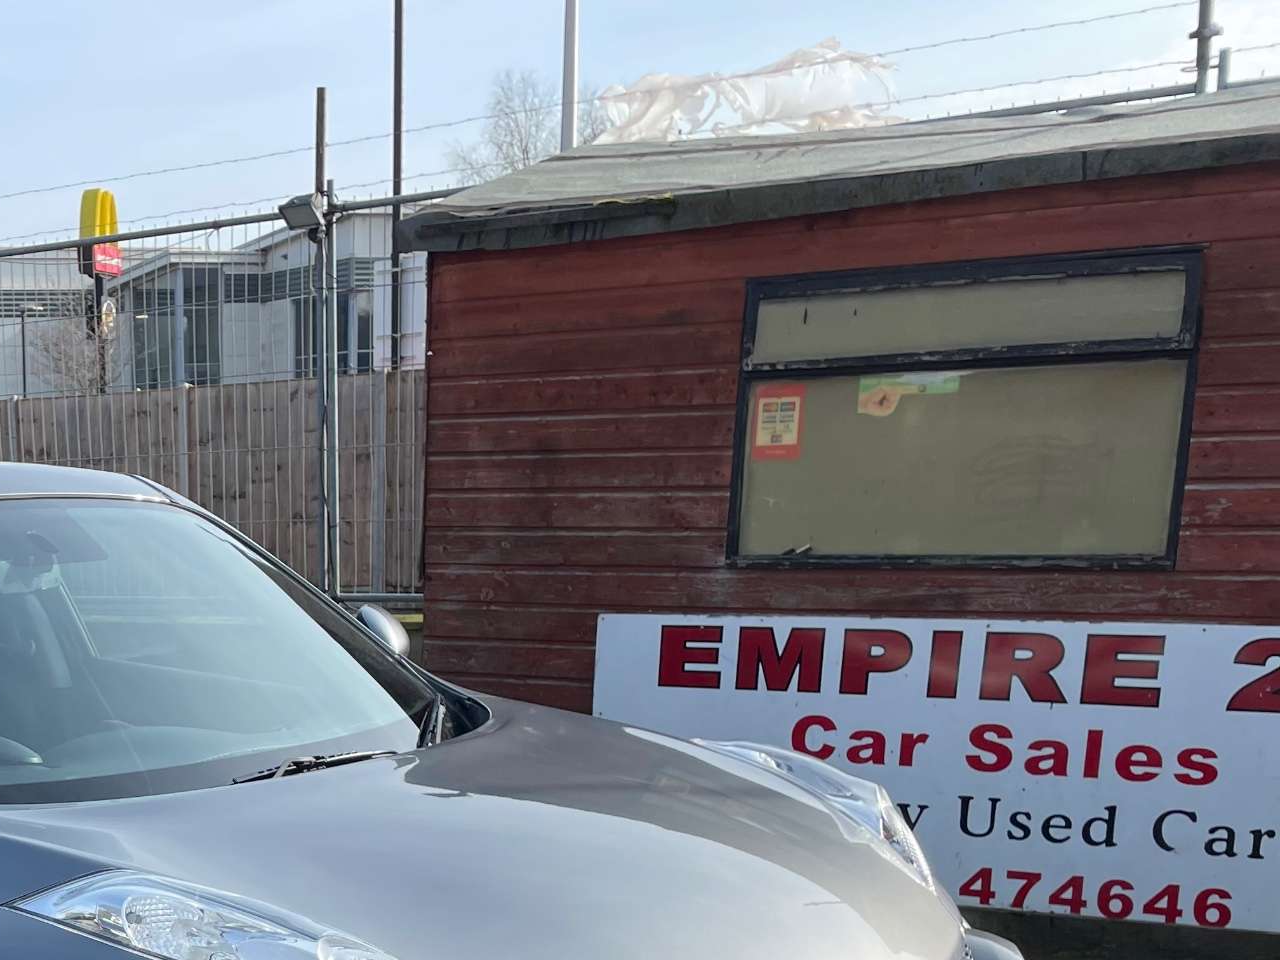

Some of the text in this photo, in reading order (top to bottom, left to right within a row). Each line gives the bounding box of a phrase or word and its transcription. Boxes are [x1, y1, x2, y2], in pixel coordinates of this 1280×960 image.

[658, 624, 1280, 712] EMPIRE 2
[790, 714, 1220, 786] Car Sales
[958, 794, 1120, 847] Used
[1152, 809, 1276, 859] Car
[958, 866, 1233, 929] 474646
